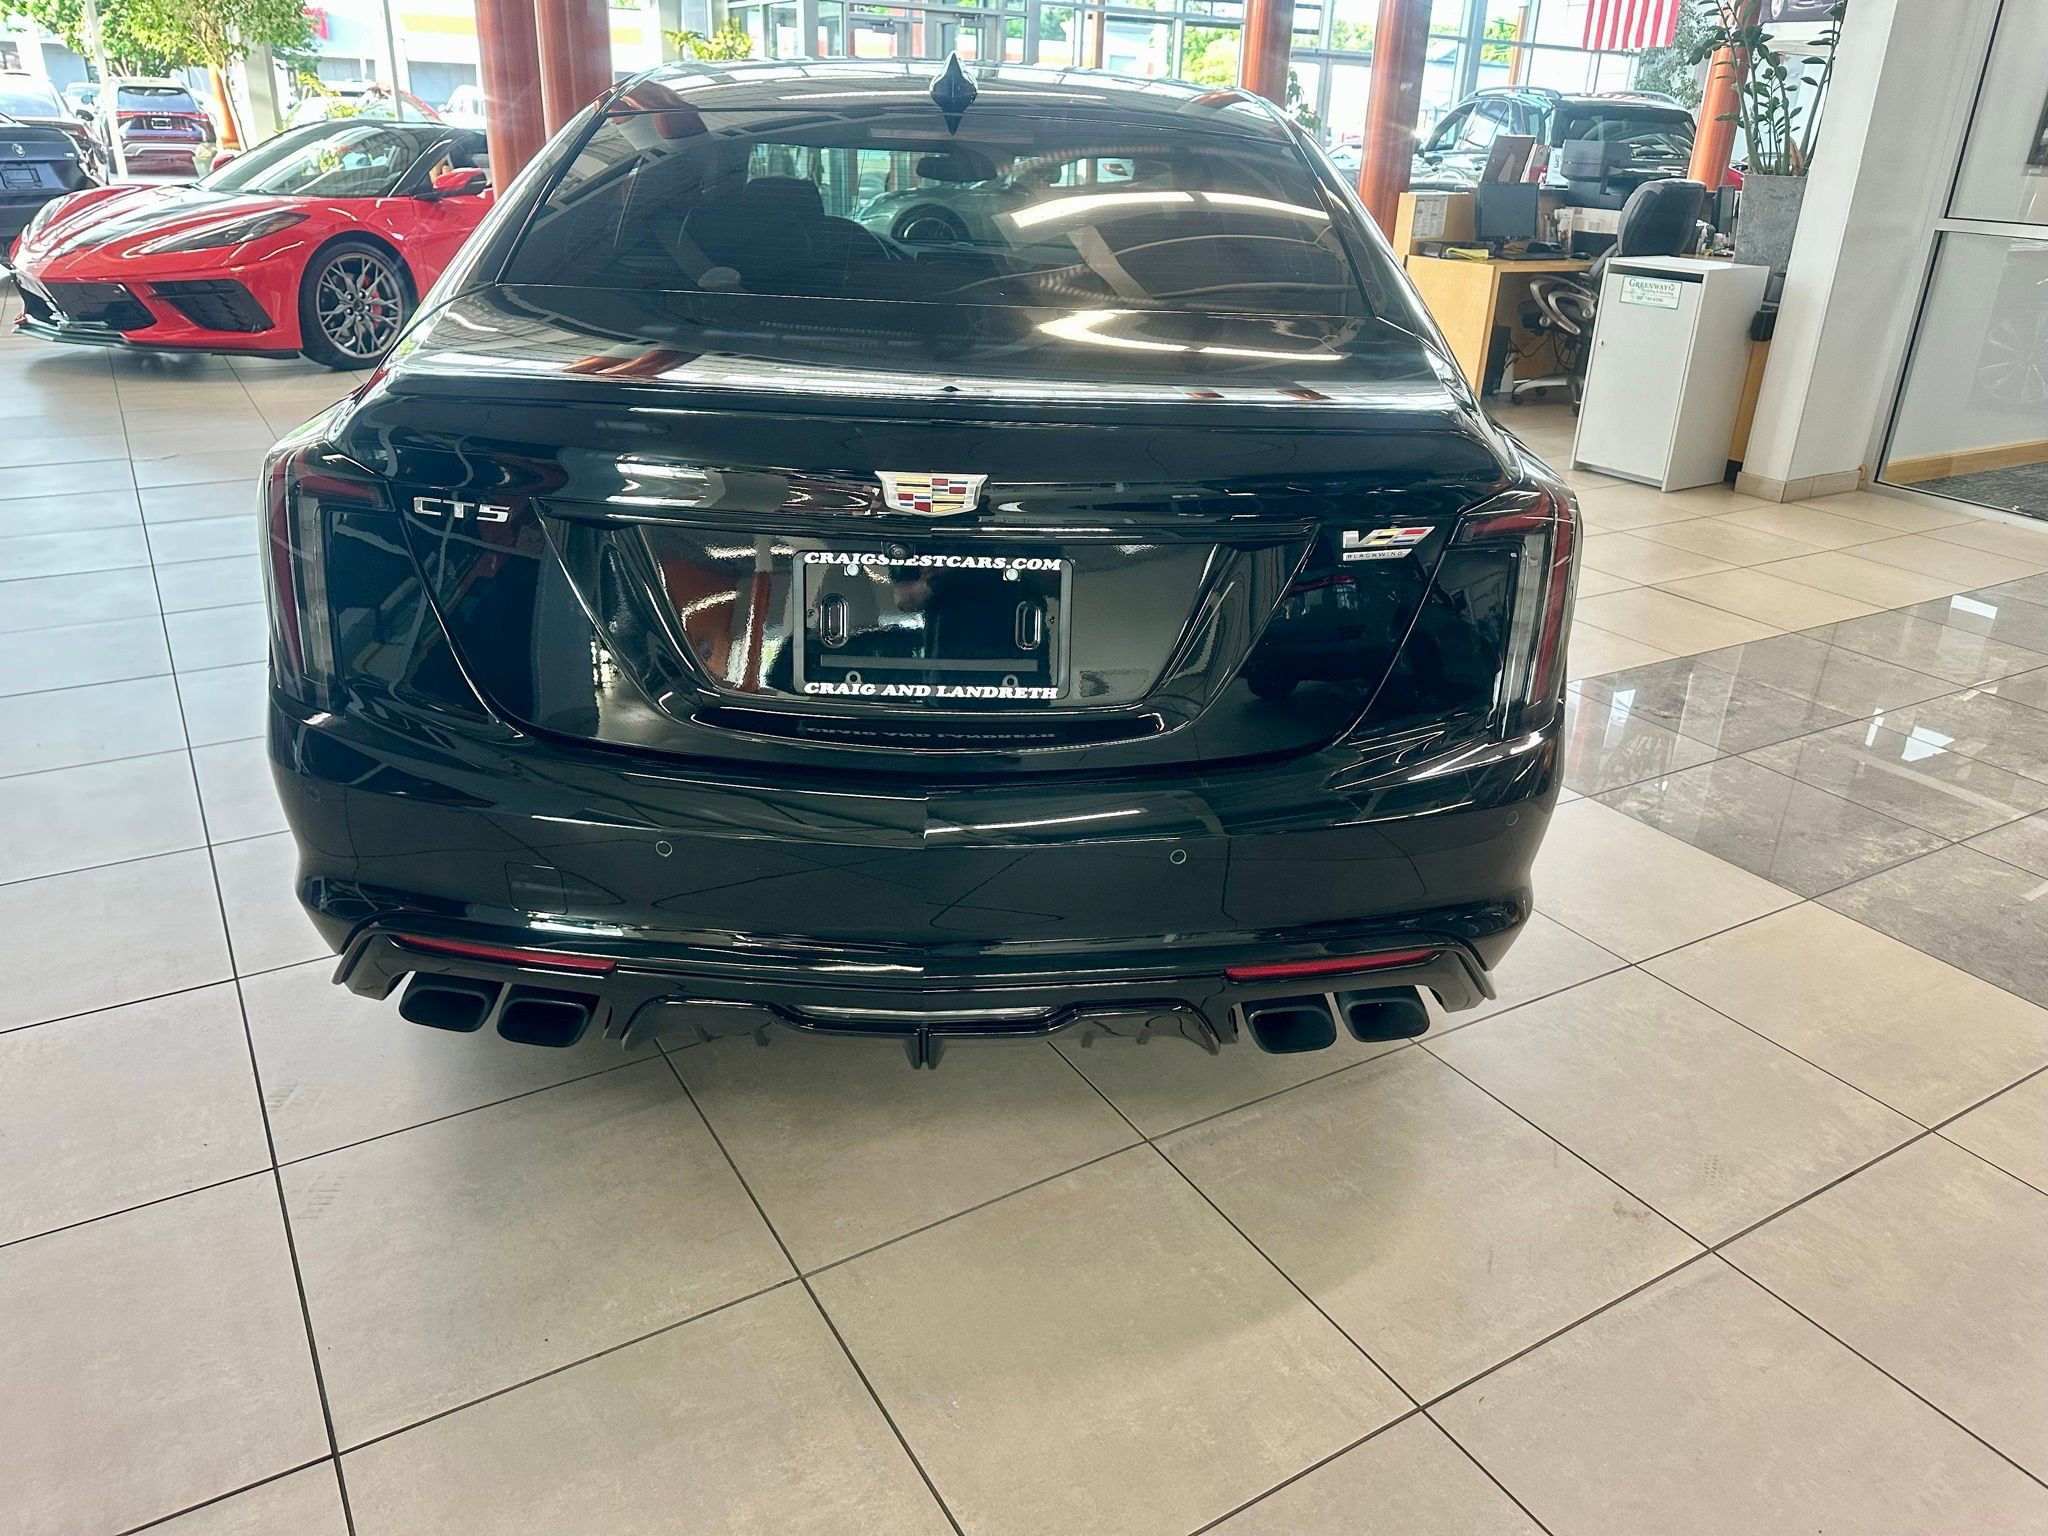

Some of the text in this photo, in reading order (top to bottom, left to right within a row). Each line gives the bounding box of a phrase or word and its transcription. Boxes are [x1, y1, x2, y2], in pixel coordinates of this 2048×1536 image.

[413, 496, 510, 523] CT5
[1346, 551, 1406, 559] BLACKWING
[803, 682, 1059, 699] CRAIG AND LANDRETH
